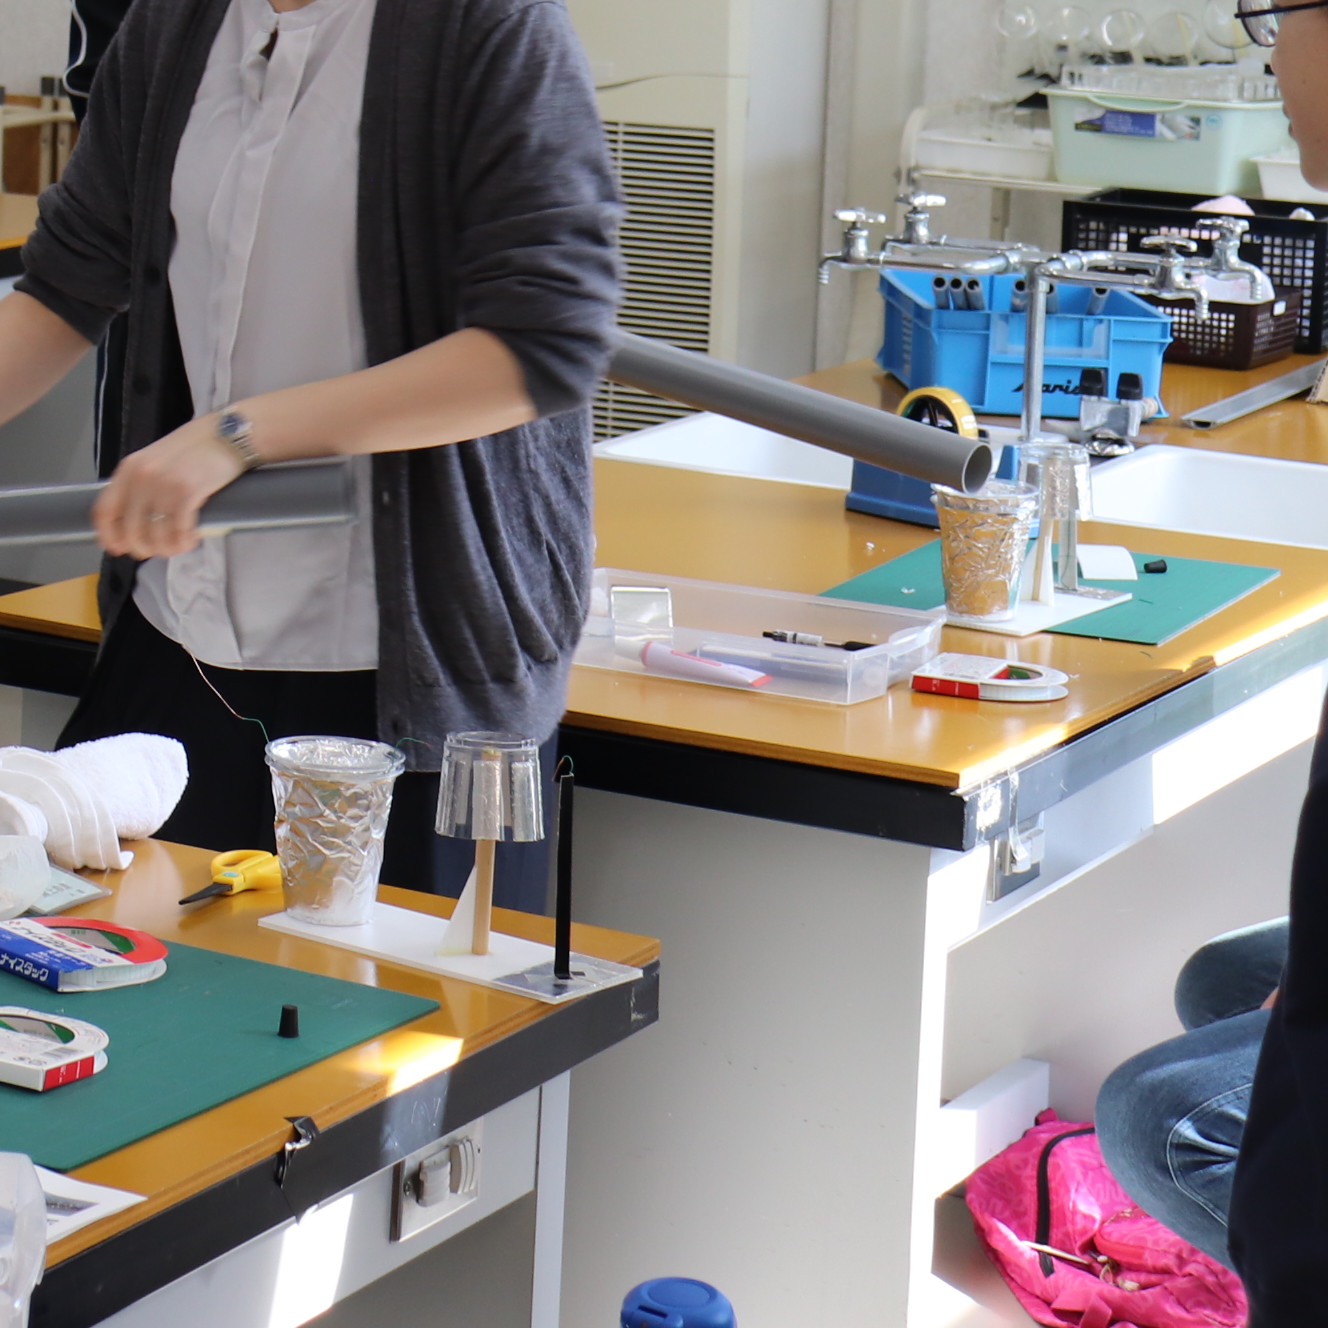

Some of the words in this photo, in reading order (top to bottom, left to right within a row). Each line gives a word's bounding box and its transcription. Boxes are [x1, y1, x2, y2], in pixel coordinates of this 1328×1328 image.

[0, 953, 49, 982] ナイスタック
